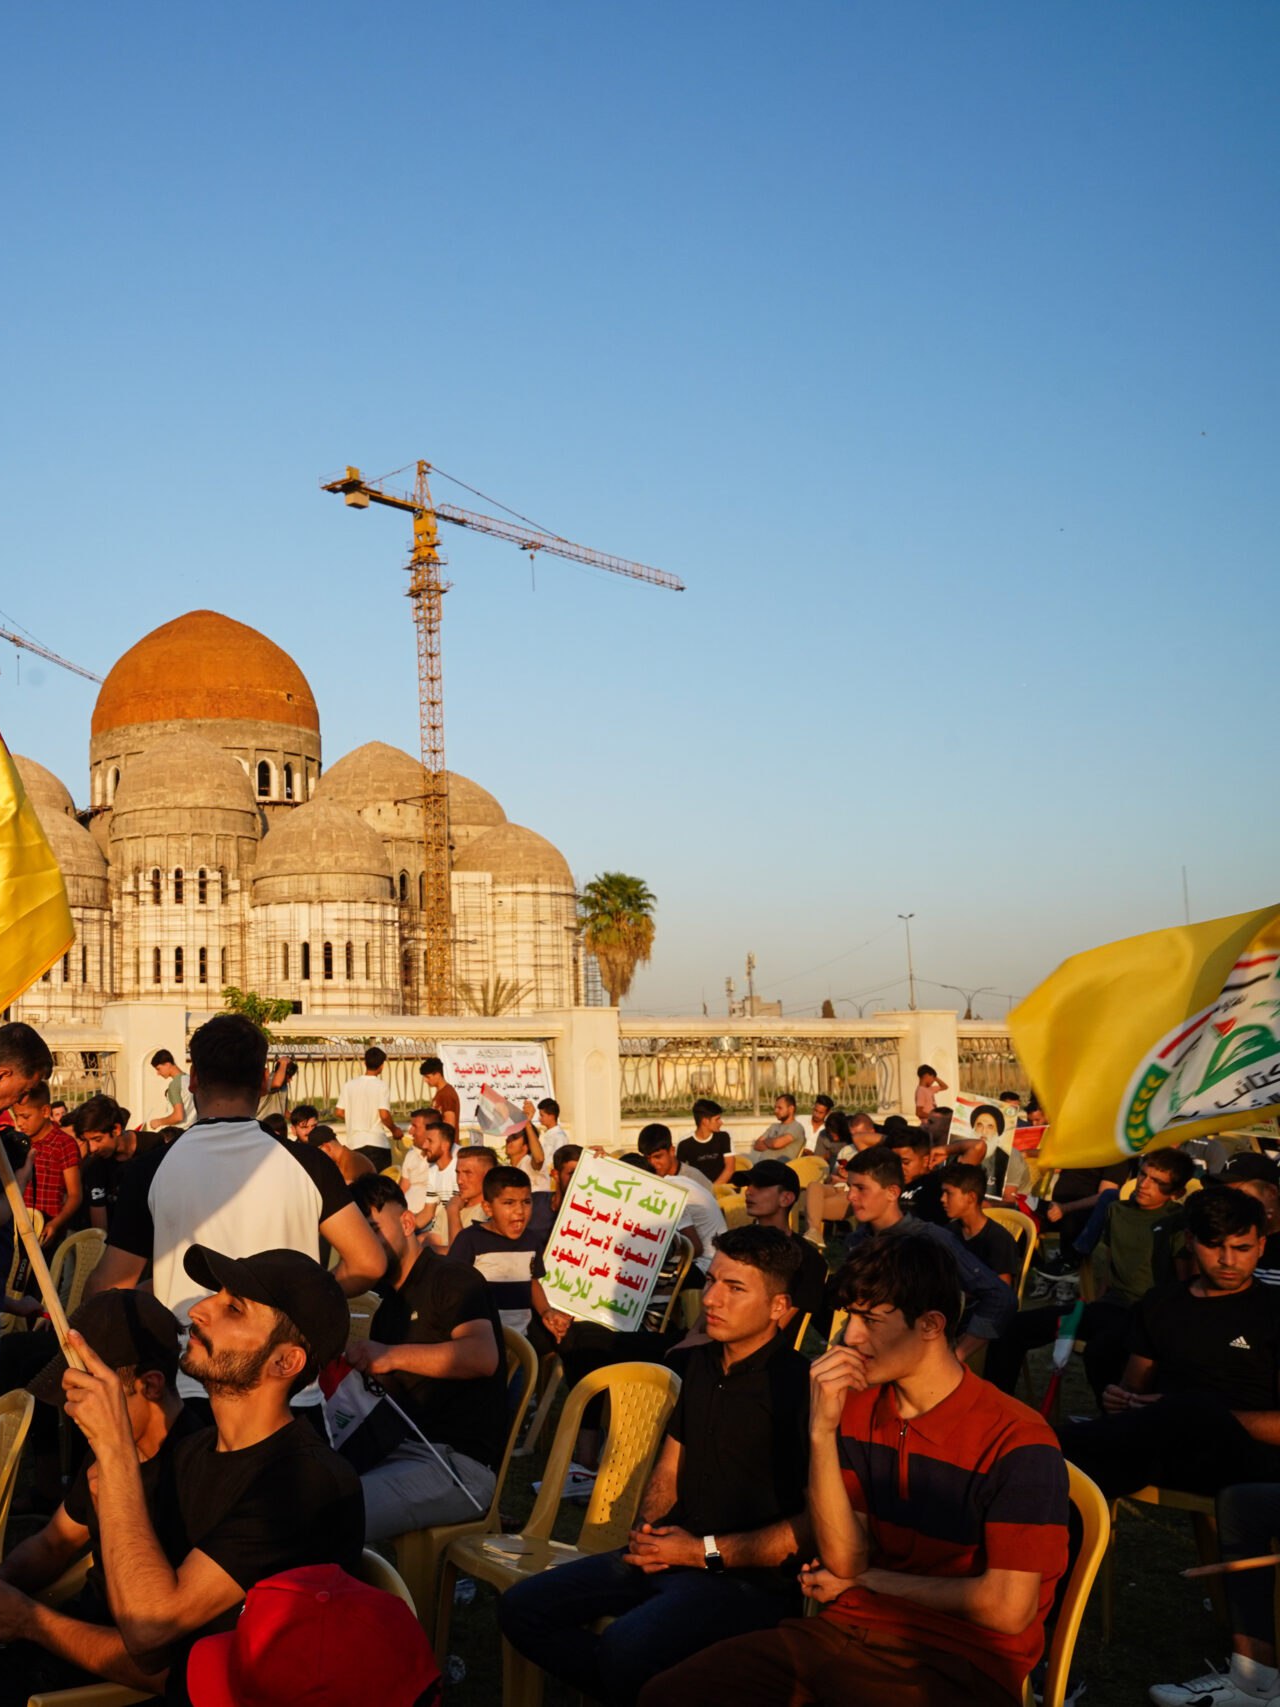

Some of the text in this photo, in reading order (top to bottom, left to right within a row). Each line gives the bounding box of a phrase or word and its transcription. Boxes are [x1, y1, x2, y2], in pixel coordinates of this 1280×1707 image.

[638, 1189, 677, 1219] الله
[622, 1217, 667, 1245] الموت
[551, 1244, 648, 1293] اللعنة على اليهود
[613, 1241, 657, 1269] الموت
[591, 1293, 640, 1318] النصر
